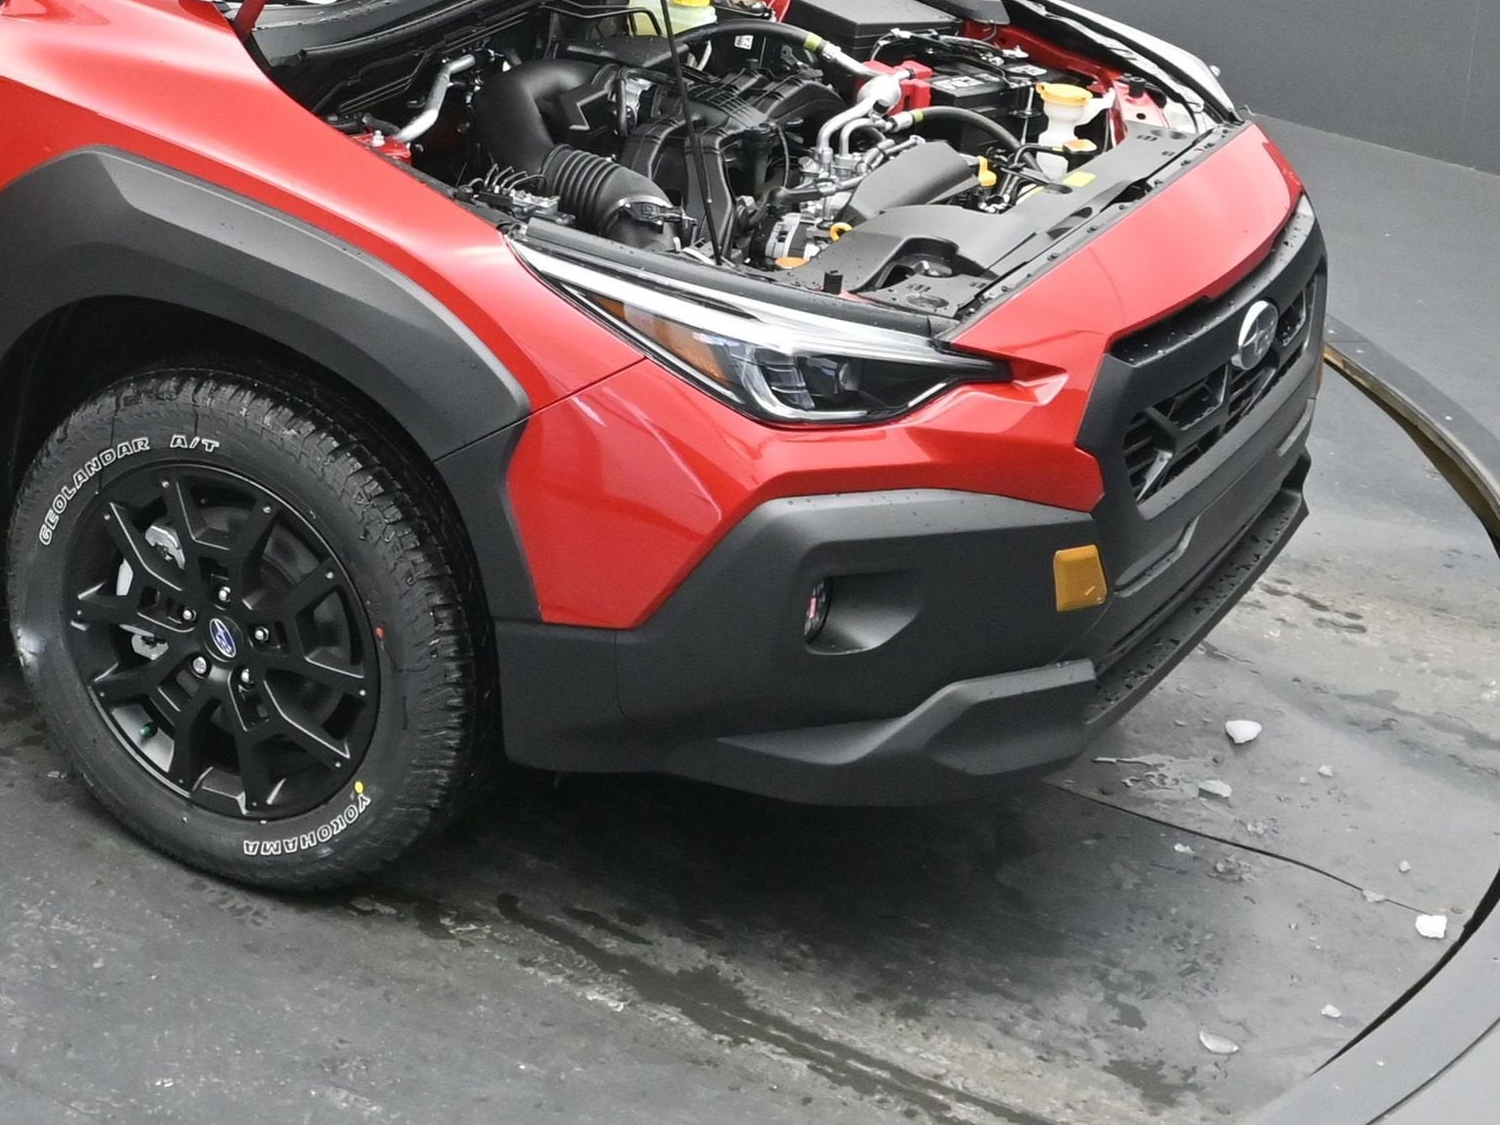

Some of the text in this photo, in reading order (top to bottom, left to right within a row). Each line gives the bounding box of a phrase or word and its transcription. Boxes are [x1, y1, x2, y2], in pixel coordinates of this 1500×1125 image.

[39, 434, 220, 545] GEOLANDAR A/T
[244, 793, 371, 855] YOKOHAMA
